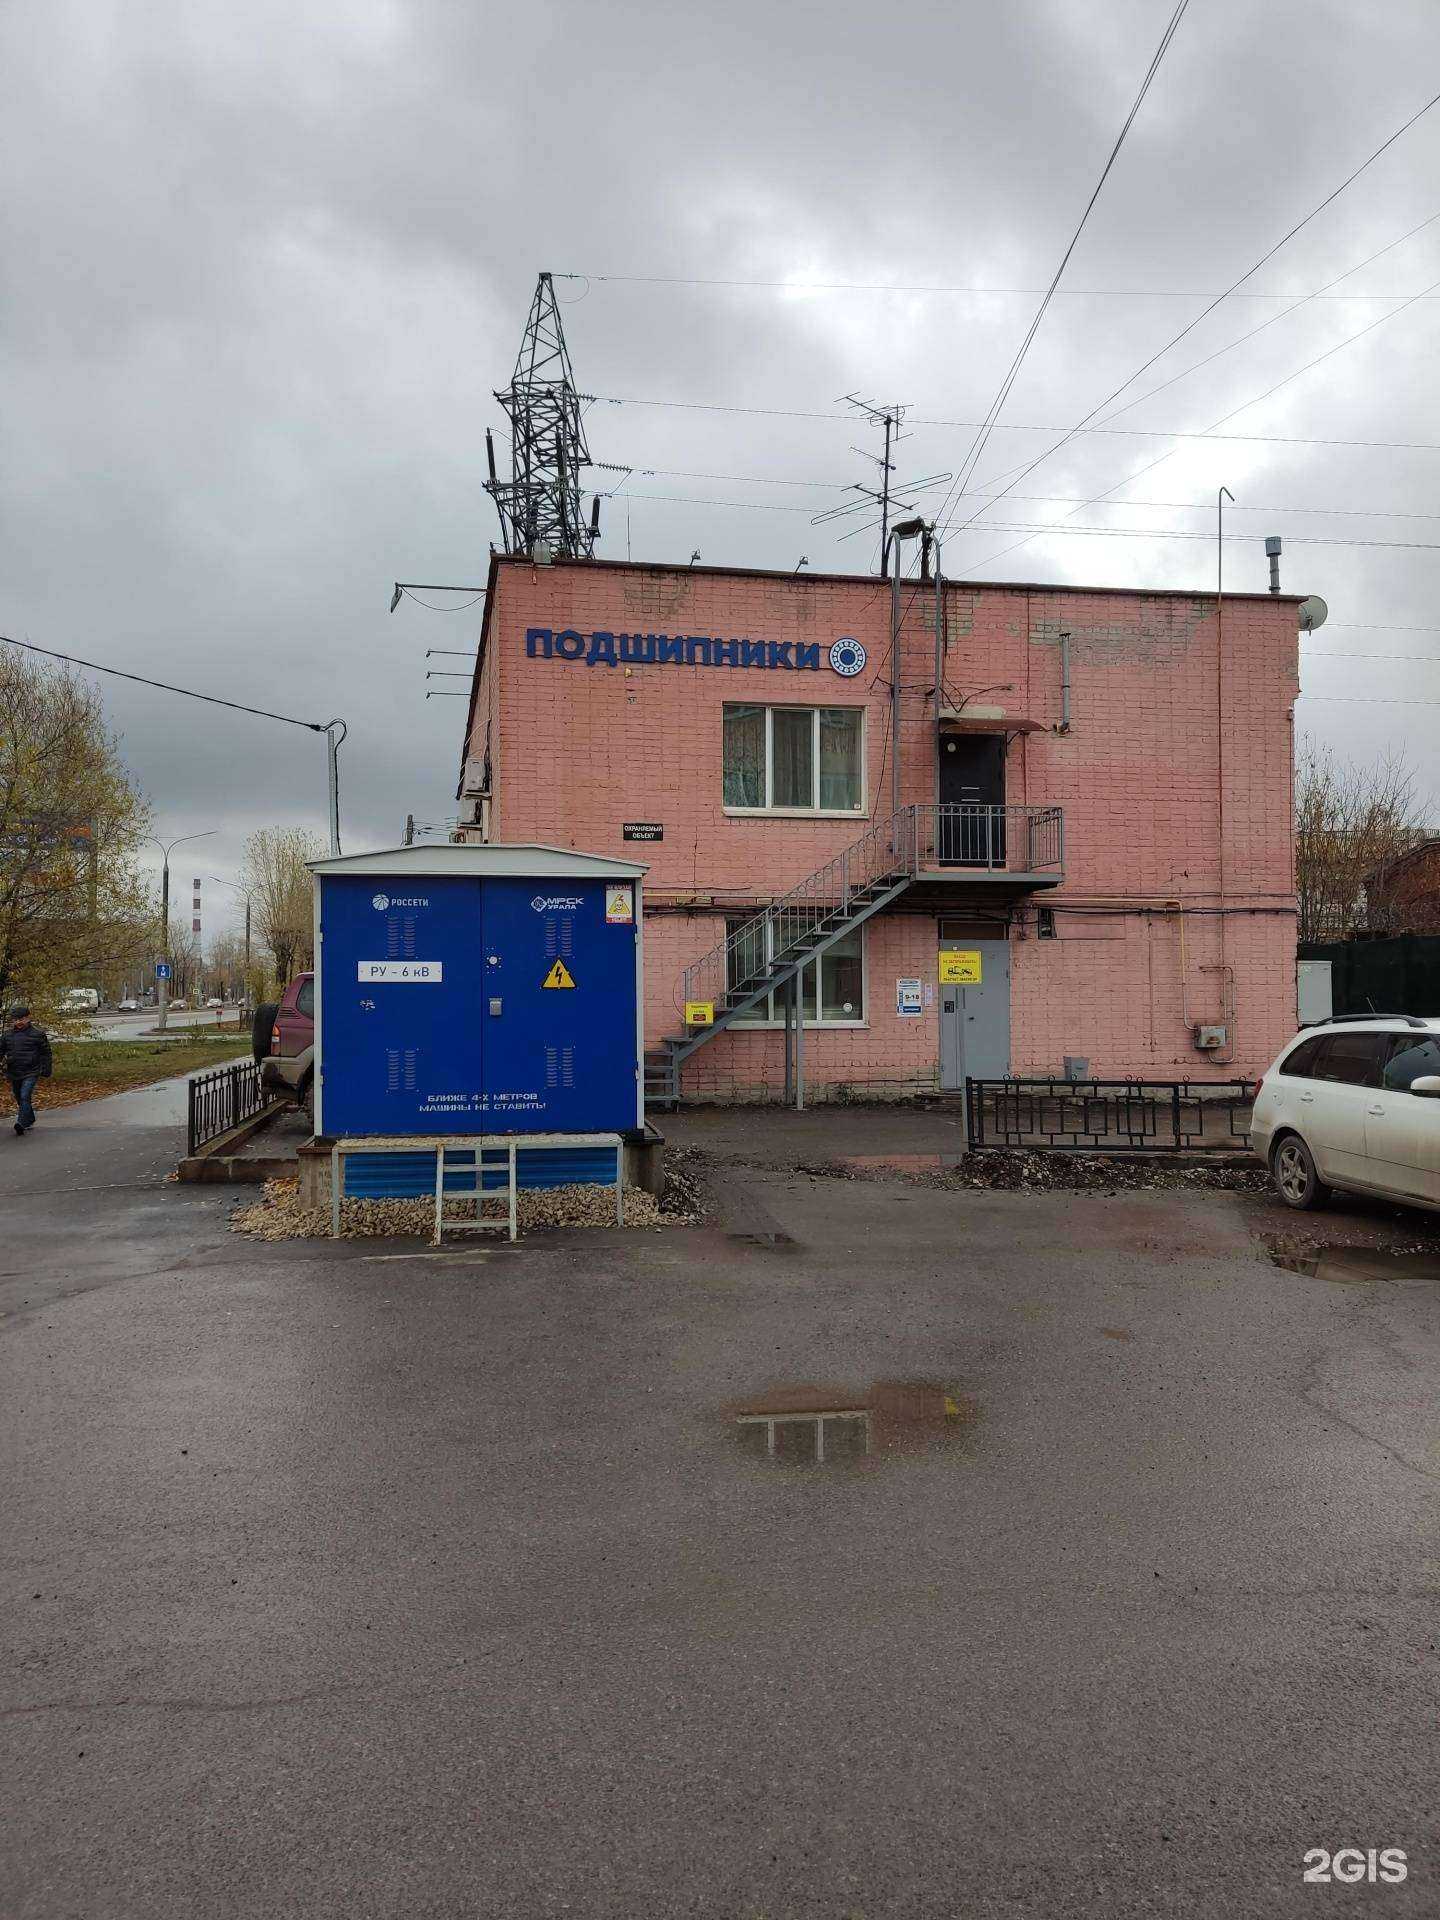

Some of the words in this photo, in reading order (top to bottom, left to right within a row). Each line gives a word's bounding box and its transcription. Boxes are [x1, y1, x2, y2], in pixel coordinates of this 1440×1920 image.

[526, 628, 820, 670] ПОДШИПНИКИ
[391, 898, 429, 906] РОССЕТИ
[546, 897, 585, 905] МРСК
[370, 966, 387, 977] РУ
[402, 966, 409, 977] 6
[427, 1094, 468, 1102] БЛИЖЕ
[493, 1093, 538, 1101] МЕТРОВ
[419, 1104, 471, 1112] МАШИНЫ
[493, 1102, 546, 1110] СТАВИТЬ!
